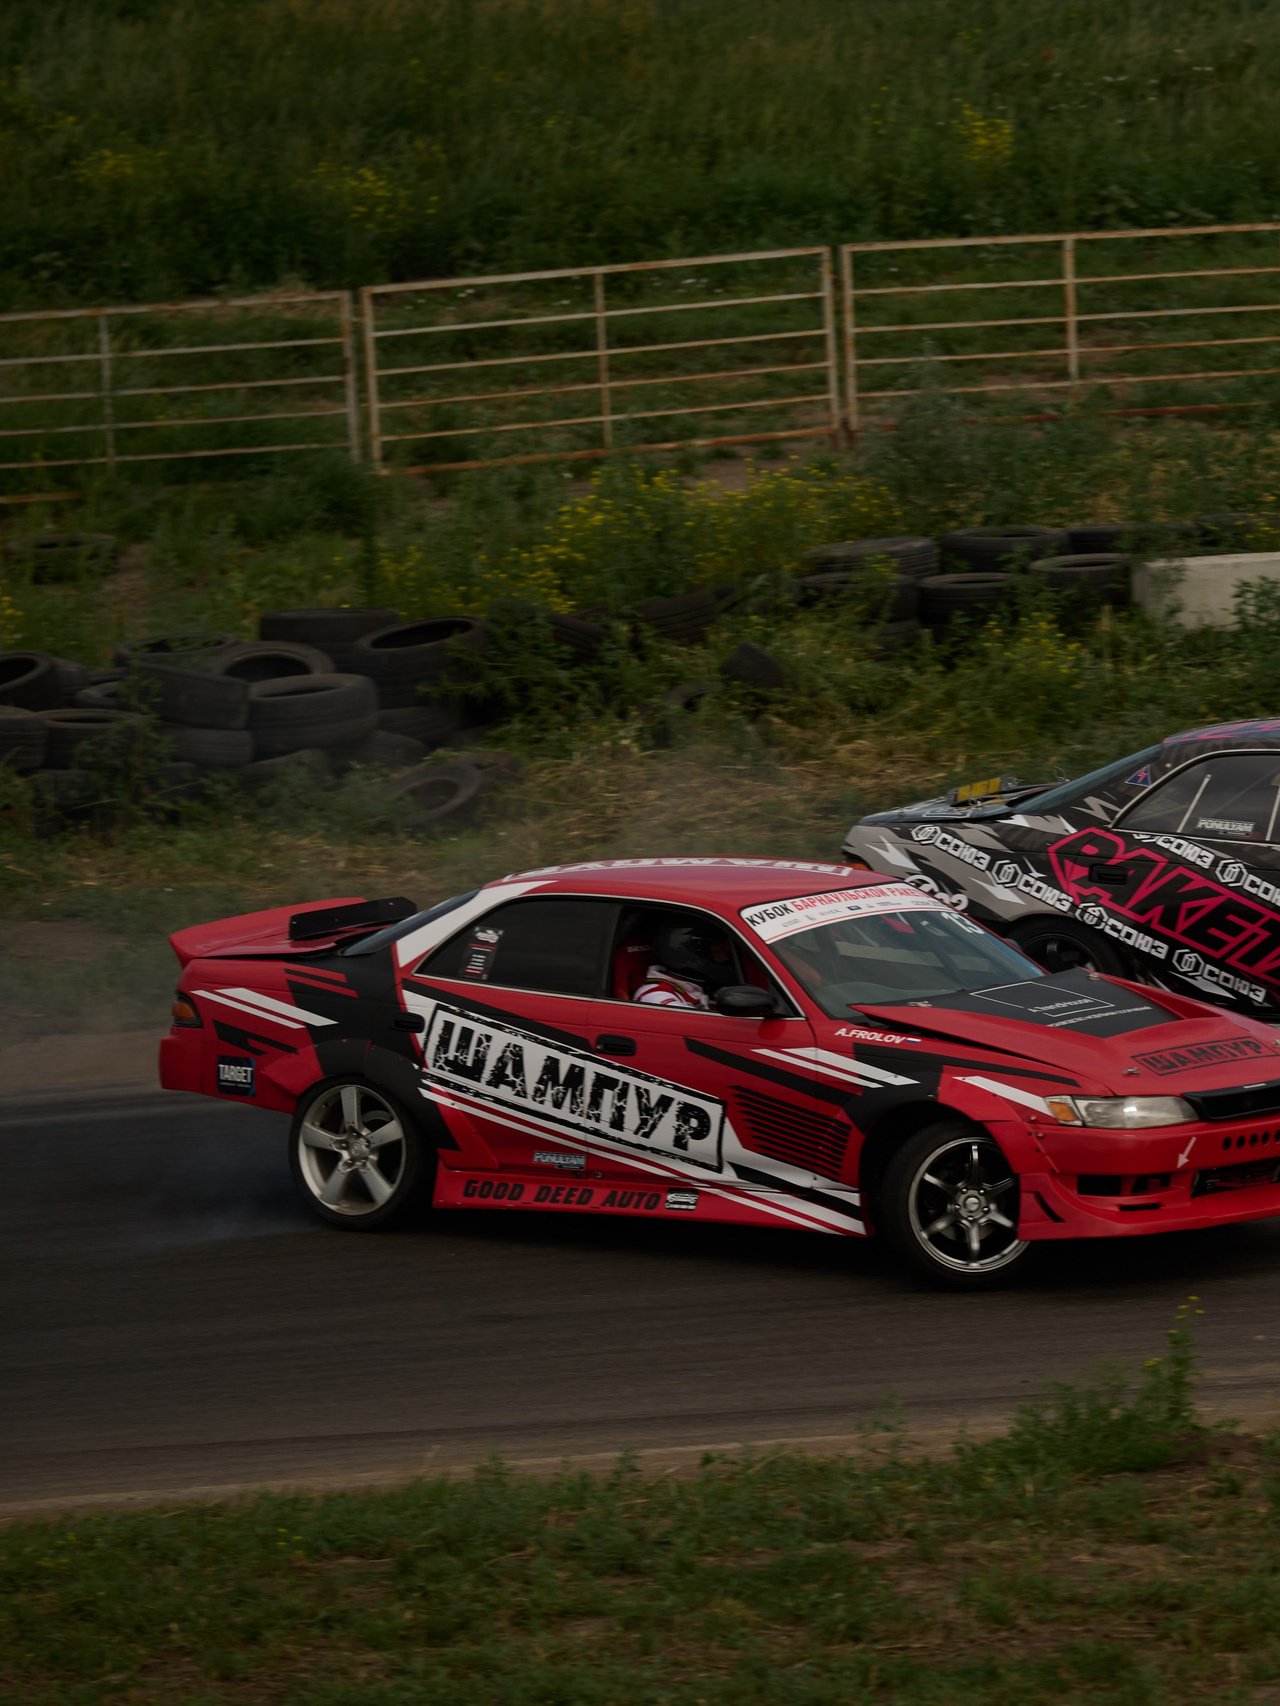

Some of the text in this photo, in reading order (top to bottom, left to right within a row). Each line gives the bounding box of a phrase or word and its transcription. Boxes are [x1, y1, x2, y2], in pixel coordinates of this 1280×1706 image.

[934, 832, 991, 871] СОЮЗ
[1156, 836, 1215, 869] СОЮЗ
[746, 904, 794, 927] КУБОК
[791, 886, 886, 912] БАРНАУЛЬСКОЙ
[1017, 874, 1074, 913] СОЮЗ
[941, 911, 985, 935] 13
[1103, 917, 1170, 960] СОЮЗ
[1201, 963, 1267, 1003] СОЮЗ
[834, 1028, 906, 1044] A.FROLOV
[218, 1064, 253, 1083] TARGET
[1142, 1040, 1263, 1071] ШАМПУР
[433, 1020, 711, 1152] ШАМПУР
[463, 1180, 524, 1201] GOOD
[534, 1185, 594, 1206] DEED
[601, 1190, 661, 1210] AUTO
